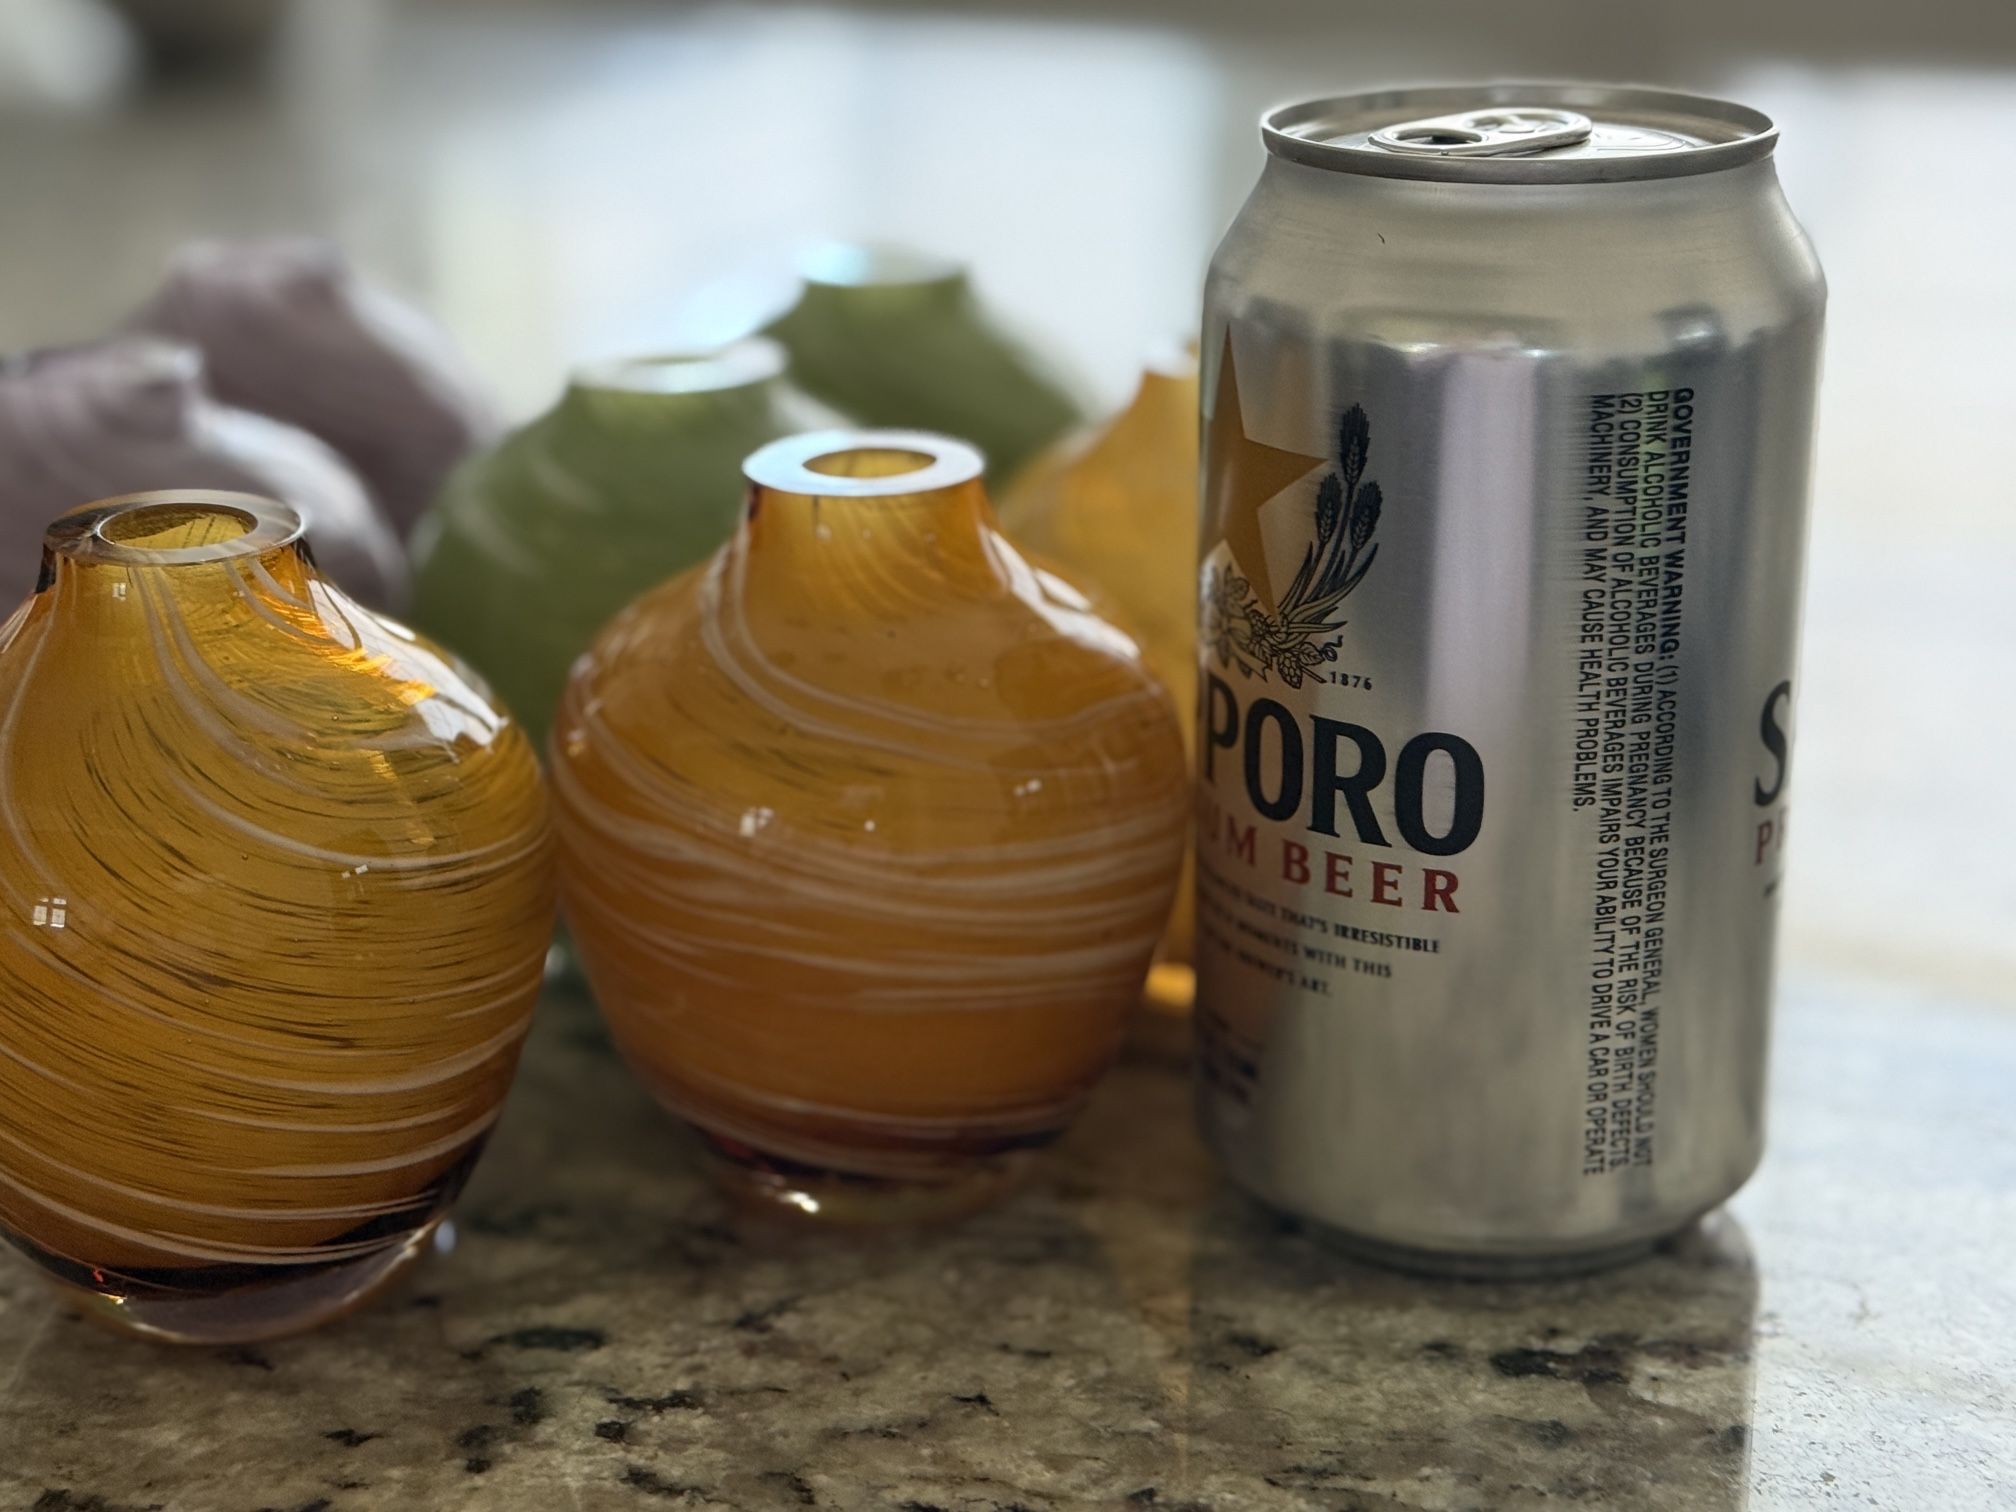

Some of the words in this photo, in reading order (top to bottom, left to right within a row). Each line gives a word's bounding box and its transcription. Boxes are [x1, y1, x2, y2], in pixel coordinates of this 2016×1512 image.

[1618, 393, 1643, 414] (2)
[1645, 391, 1669, 444] DRINK
[1584, 394, 1615, 501] MACHINERY,
[1667, 388, 1694, 544] GOVERNMENT
[1613, 420, 1642, 545] CONSUMPTION
[1640, 451, 1665, 548] ALCOHOLIC
[1585, 506, 1609, 541] AND
[1583, 548, 1608, 583] MAY
[1612, 552, 1634, 573] OF
[1581, 589, 1606, 643] CAUSE
[1607, 578, 1632, 672] ALCOHOLIC
[1635, 556, 1659, 654] BEVERAGES
[1660, 549, 1685, 660] WARNING:
[1329, 671, 1373, 690] 1876
[1577, 648, 1602, 713] HEALTH
[1631, 662, 1654, 724] DURING
[1656, 666, 1679, 685] (1)
[1602, 678, 1628, 773] BEVERAGES
[1653, 690, 1677, 784] ACCORDING
[1754, 679, 1792, 807] S
[1573, 718, 1599, 812] PROBLEMS.
[1626, 732, 1650, 829] PREGNANCY
[1599, 779, 1623, 844] IMPAIRS
[1652, 788, 1672, 809] TO
[1650, 812, 1670, 845] THE
[1283, 840, 1460, 914] BEER
[1597, 847, 1619, 891] YOUR
[1622, 836, 1645, 910] BECAUSE
[1644, 848, 1668, 923] SURGEON
[1333, 922, 1440, 954] IRRESISTIBLE
[1593, 895, 1617, 955] ABILITY
[1620, 916, 1641, 935] OF
[1303, 944, 1347, 969] WITH
[1353, 957, 1393, 979] THIS
[1592, 958, 1614, 978] TO
[1619, 941, 1640, 972] THE
[1638, 927, 1663, 1005] GENERAL,
[1590, 984, 1613, 1029] DRIVE
[1617, 980, 1637, 1015] RISK
[1589, 1033, 1610, 1044] A
[1615, 1021, 1635, 1040] OF
[1638, 1007, 1660, 1068] WOMEN
[1588, 1047, 1610, 1077] CAR
[1613, 1047, 1634, 1092] BIRTH
[1586, 1082, 1608, 1103] OR
[1635, 1072, 1656, 1133] SHOULD
[1583, 1108, 1607, 1176] OPERATE
[1634, 1137, 1653, 1167] NOT
